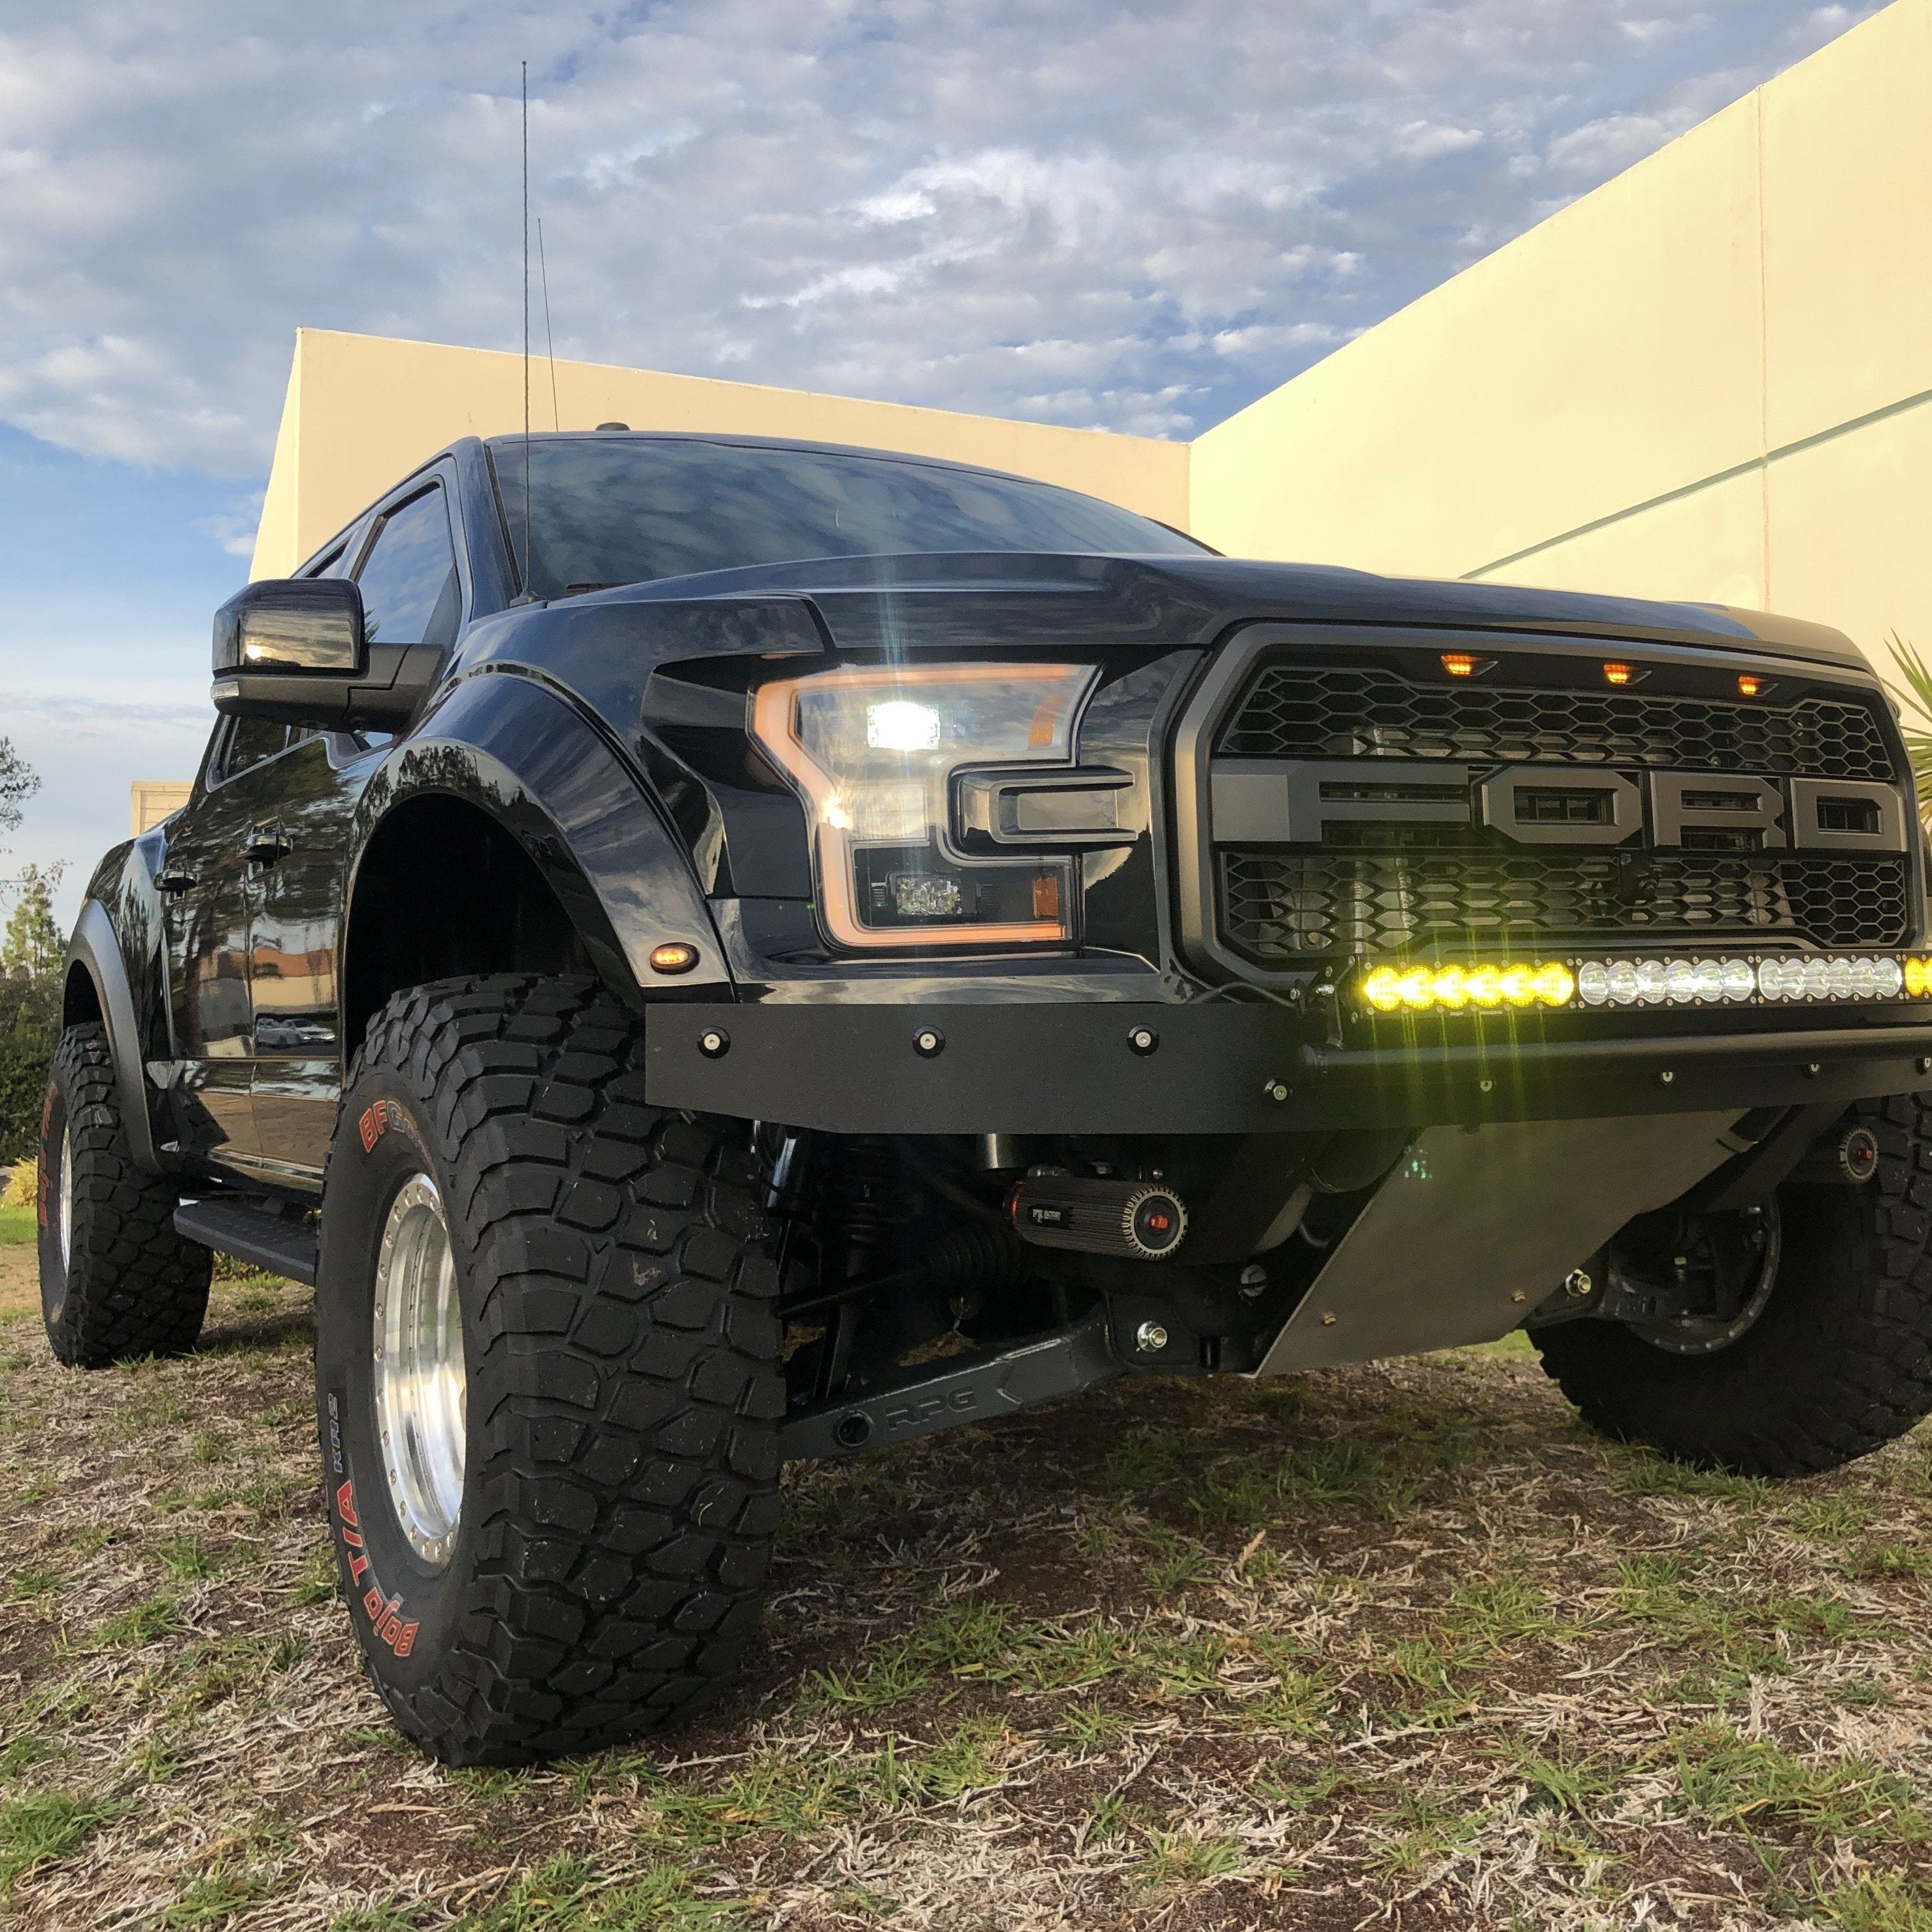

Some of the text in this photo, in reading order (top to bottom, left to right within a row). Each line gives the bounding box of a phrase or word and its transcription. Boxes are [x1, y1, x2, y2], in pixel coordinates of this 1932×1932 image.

[1211, 759, 1907, 851] FORD
[886, 1386, 977, 1431] RPG
[363, 1586, 420, 1657] Baja
